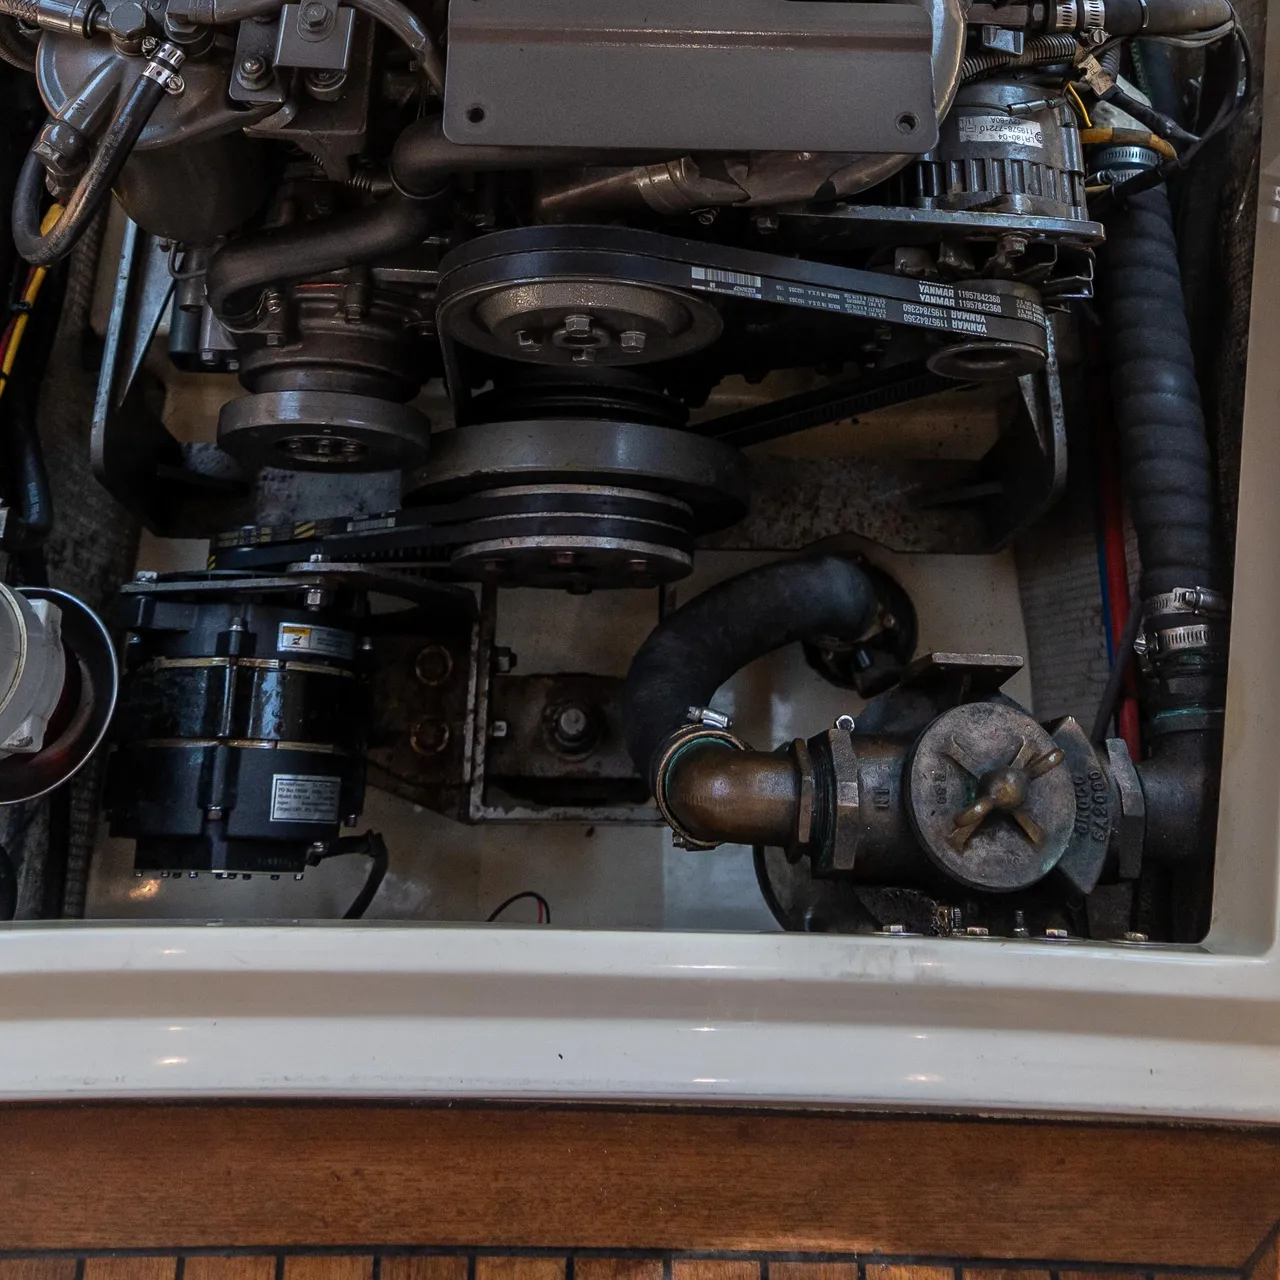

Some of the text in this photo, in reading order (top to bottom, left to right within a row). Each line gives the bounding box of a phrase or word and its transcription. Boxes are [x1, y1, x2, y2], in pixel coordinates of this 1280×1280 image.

[919, 284, 954, 297] YANMAR
[919, 294, 955, 307] YANMAR
[951, 310, 986, 323] YANMAR
[952, 320, 987, 333] YANMAR
